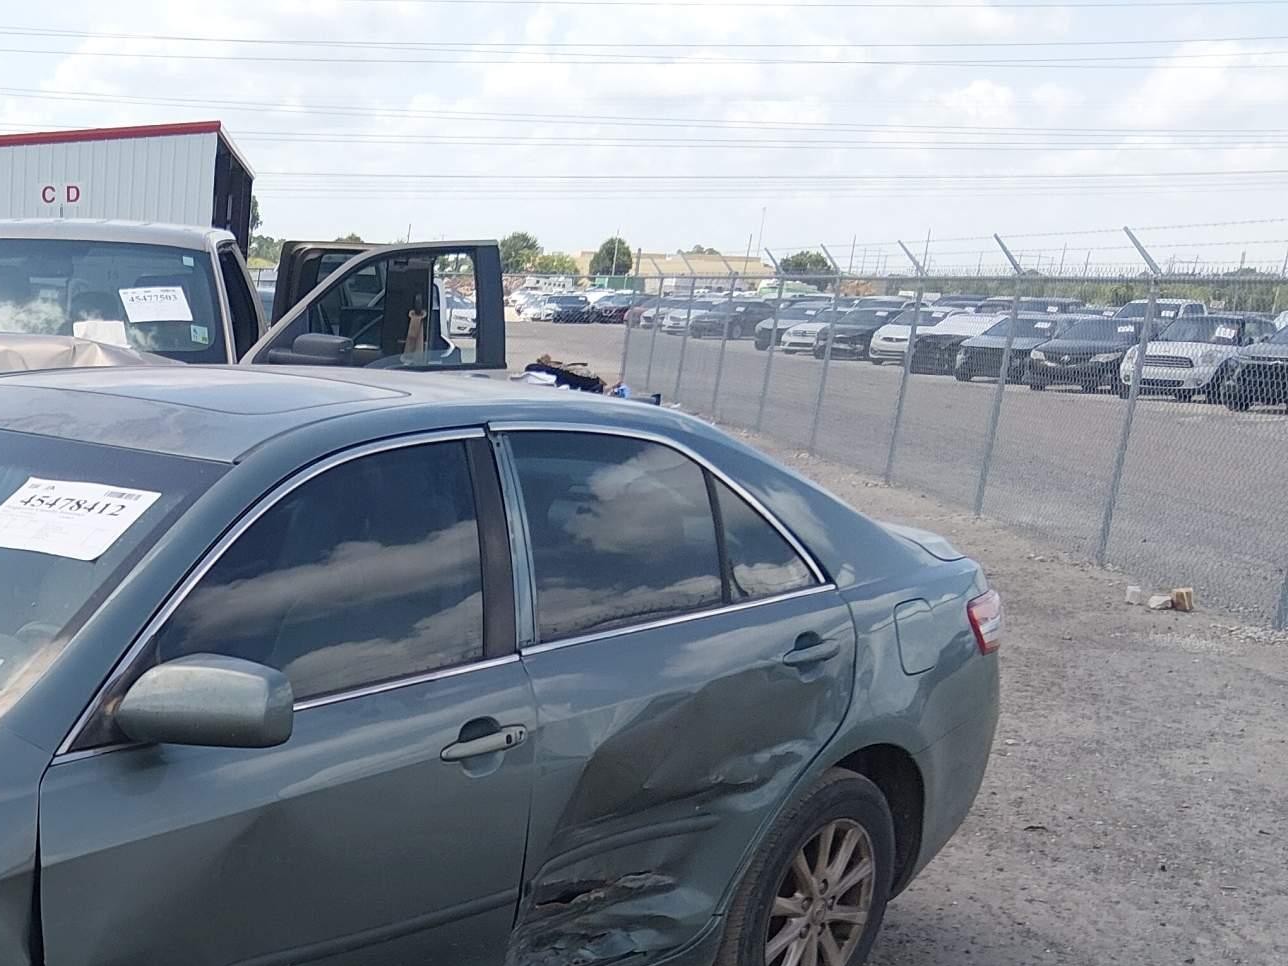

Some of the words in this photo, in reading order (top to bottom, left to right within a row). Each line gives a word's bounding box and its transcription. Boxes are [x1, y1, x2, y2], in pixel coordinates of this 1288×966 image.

[42, 185, 56, 204] C
[66, 185, 80, 203] D
[20, 494, 126, 517] 45478412
